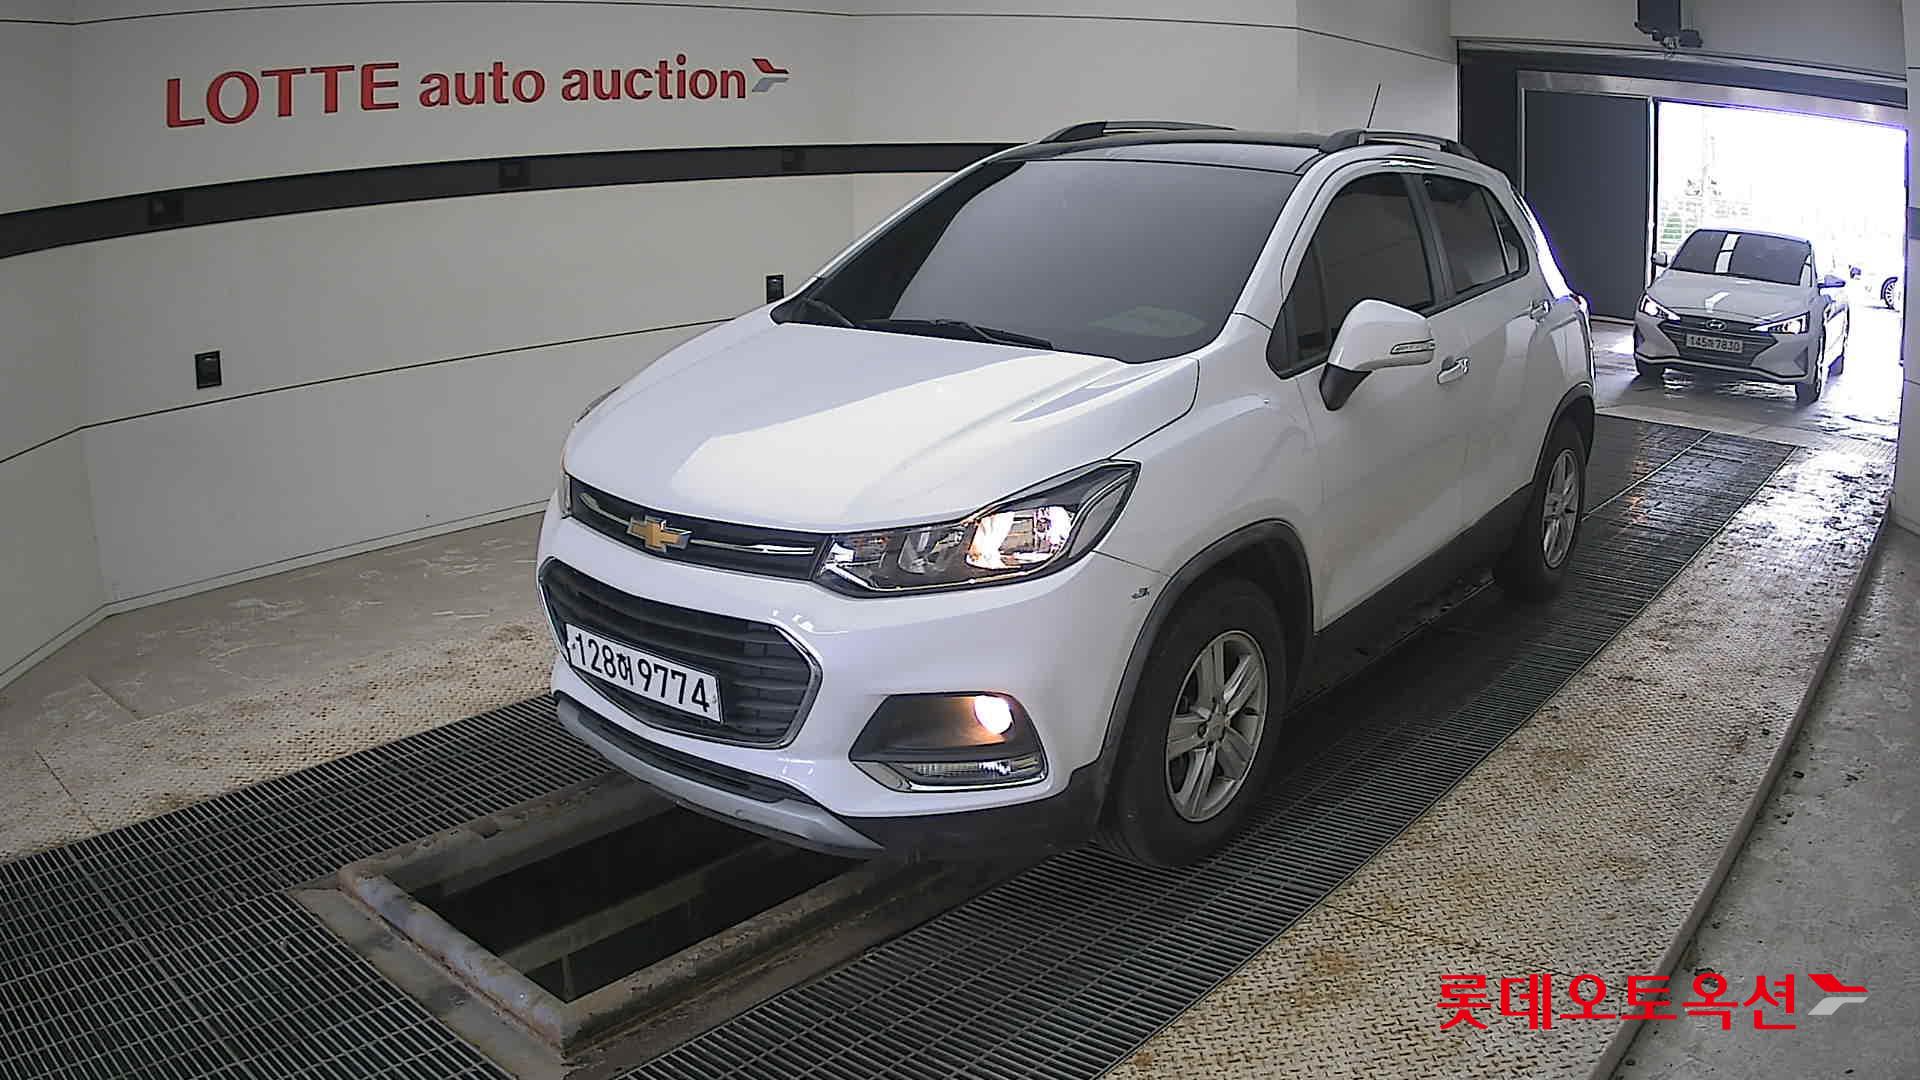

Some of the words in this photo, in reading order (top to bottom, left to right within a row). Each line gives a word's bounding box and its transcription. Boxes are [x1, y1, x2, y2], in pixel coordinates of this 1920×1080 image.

[165, 62, 399, 129] LOTTE
[418, 62, 547, 108] auto
[562, 54, 748, 102] auction
